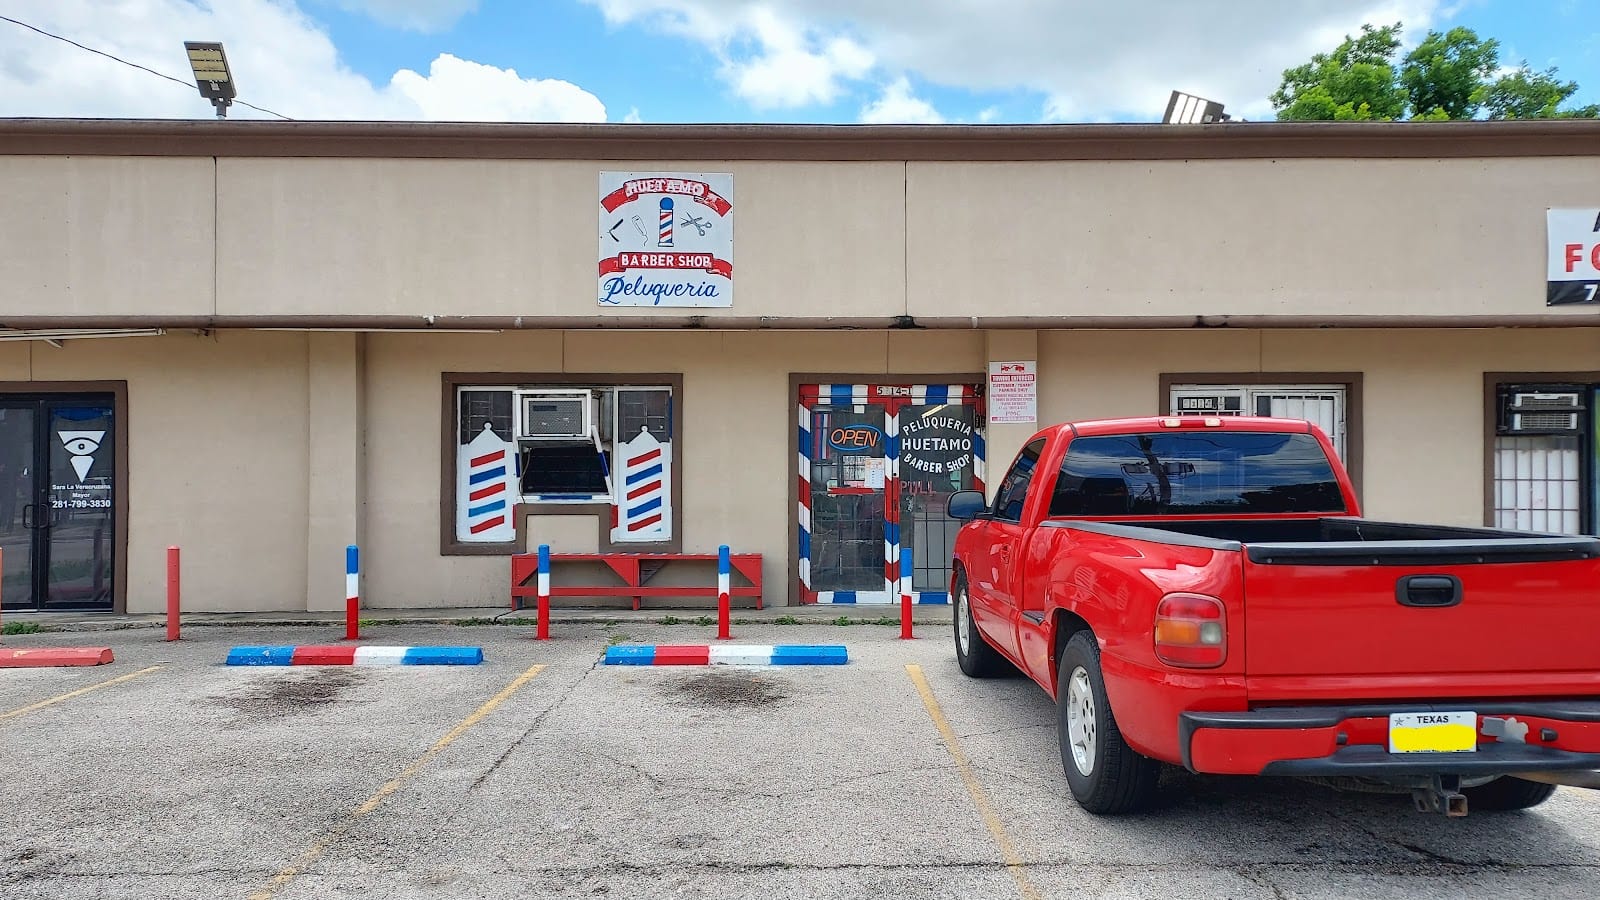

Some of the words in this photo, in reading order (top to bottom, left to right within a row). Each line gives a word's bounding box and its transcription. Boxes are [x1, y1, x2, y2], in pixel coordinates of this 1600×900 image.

[624, 178, 705, 197] HUETAMO
[621, 254, 674, 267] BARBER
[678, 255, 712, 268] SHOP
[599, 275, 719, 305] Peluqueria
[902, 416, 972, 436] PELUQUERIA
[831, 429, 878, 447] OPEN
[902, 437, 972, 451] HUETAMO
[903, 453, 943, 473] BARBER
[946, 453, 970, 472] SHOP
[52, 500, 111, 508] 281-799-3830
[1416, 715, 1449, 724] TEXAS
